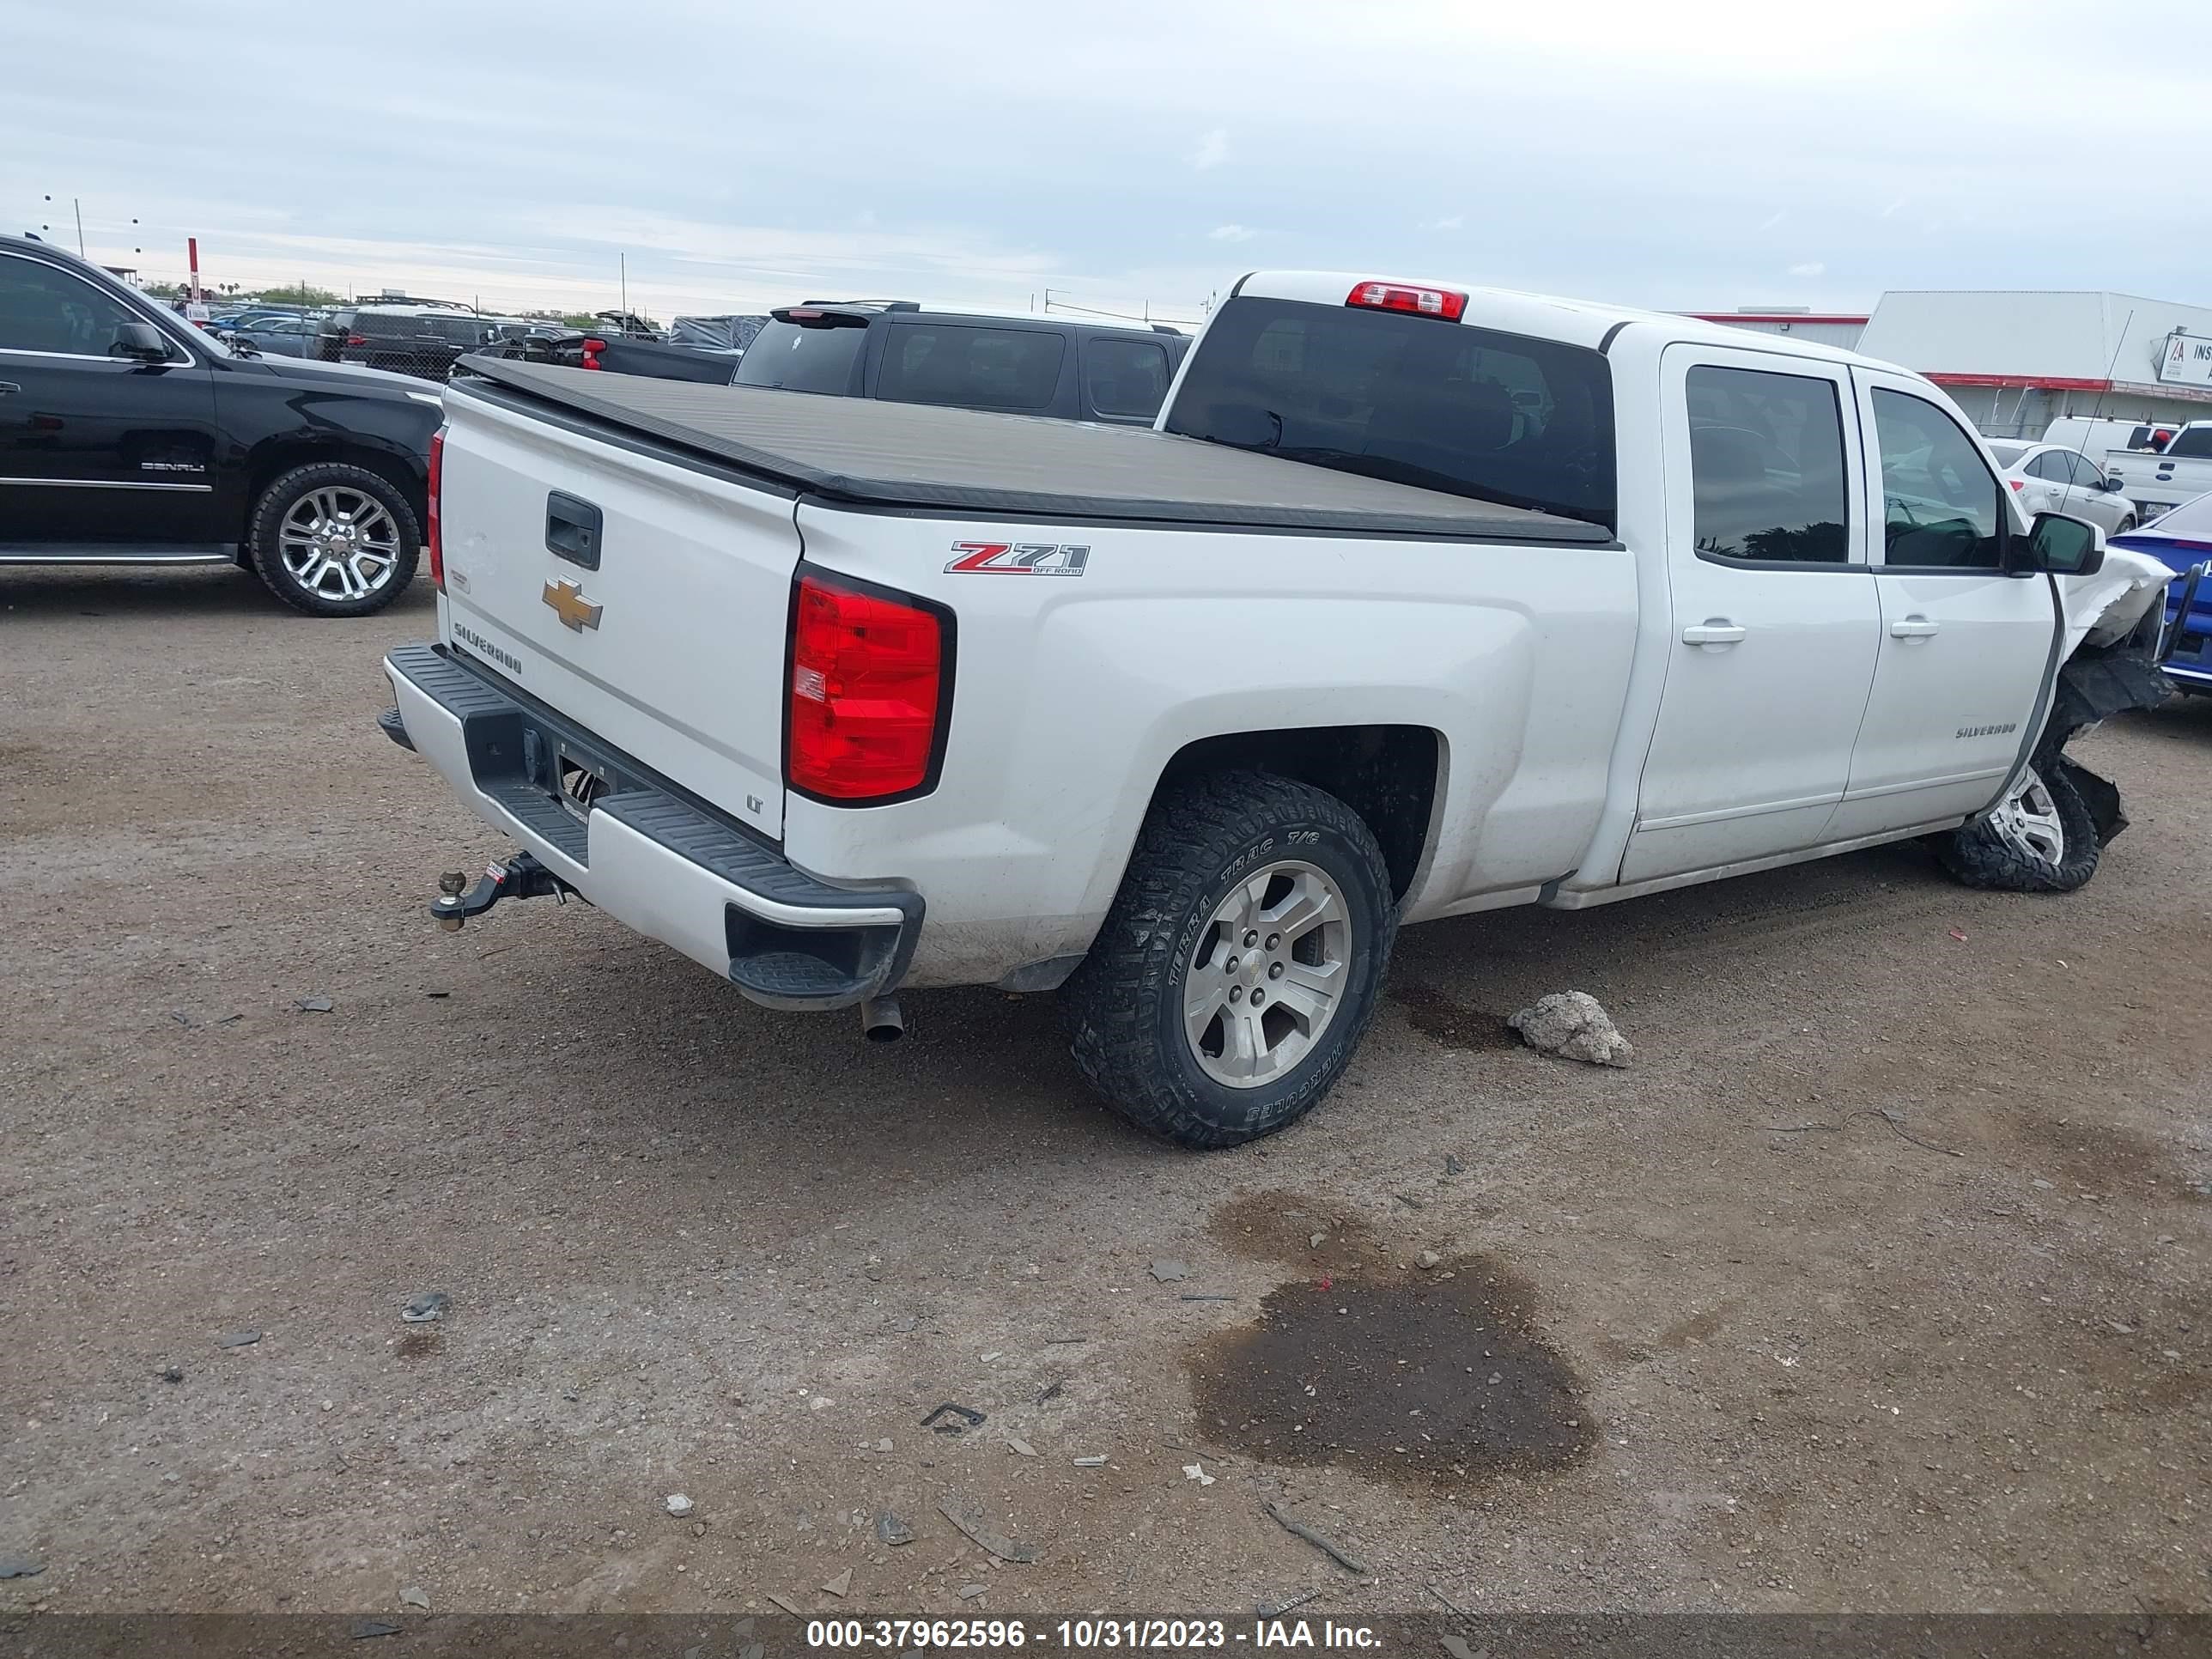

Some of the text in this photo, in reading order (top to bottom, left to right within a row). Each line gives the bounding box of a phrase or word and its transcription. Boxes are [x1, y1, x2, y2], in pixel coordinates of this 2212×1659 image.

[141, 462, 205, 472] DENALI
[943, 540, 1091, 577] Z71
[453, 622, 522, 675] SILVERADO
[1955, 723, 2016, 739] SILVERADO
[746, 794, 763, 815] LT
[1167, 894, 1212, 987] TERRA
[1220, 837, 1274, 886] TRAC
[1245, 1042, 1345, 1121] HERCULES
